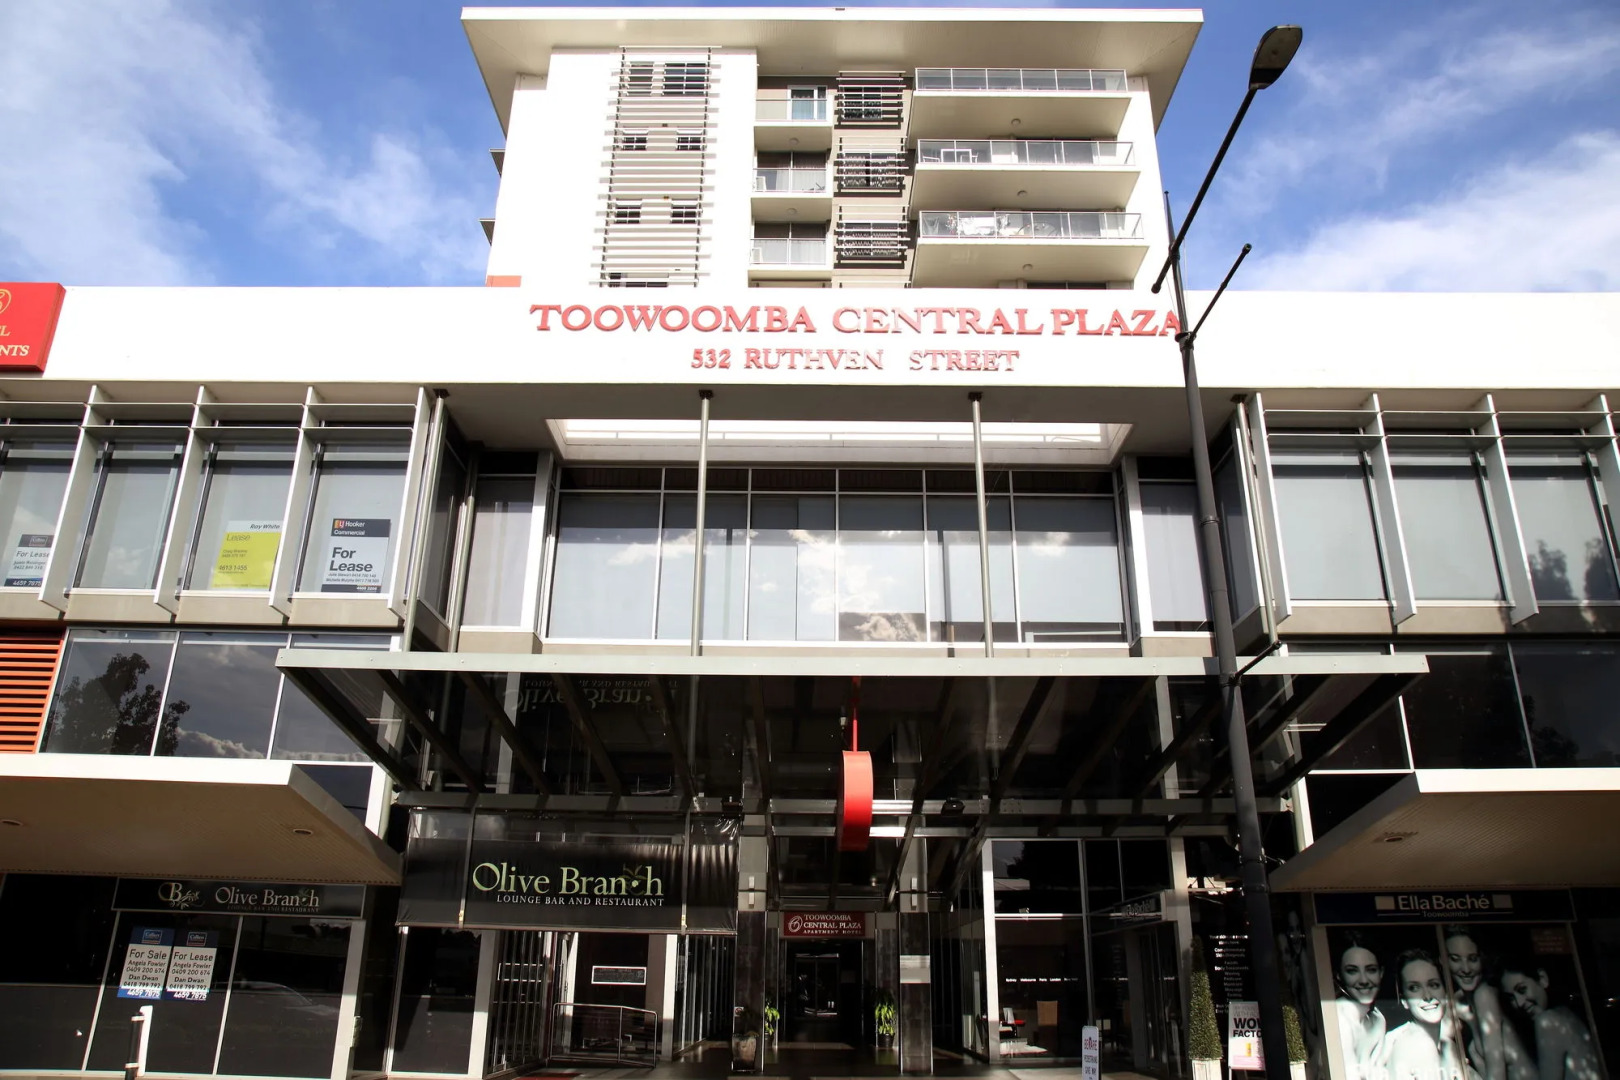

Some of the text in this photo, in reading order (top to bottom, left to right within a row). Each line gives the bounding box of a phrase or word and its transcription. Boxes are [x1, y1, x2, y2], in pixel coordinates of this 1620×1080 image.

[529, 304, 1181, 337] TOOWOOMBA CENTRAL PLAZA
[691, 345, 1020, 372] 532 RUTHVEN STREET
[332, 547, 356, 559] For
[329, 560, 373, 572] Lease
[472, 862, 550, 894] Olive
[215, 887, 258, 905] Olive
[496, 894, 665, 907] LOUNGE BAR AND RESTAURANT
[1397, 893, 1490, 911] Ella Baché
[129, 948, 167, 960] For Sale
[173, 951, 213, 962] For Lease
[1233, 1030, 1262, 1038] FACTO
